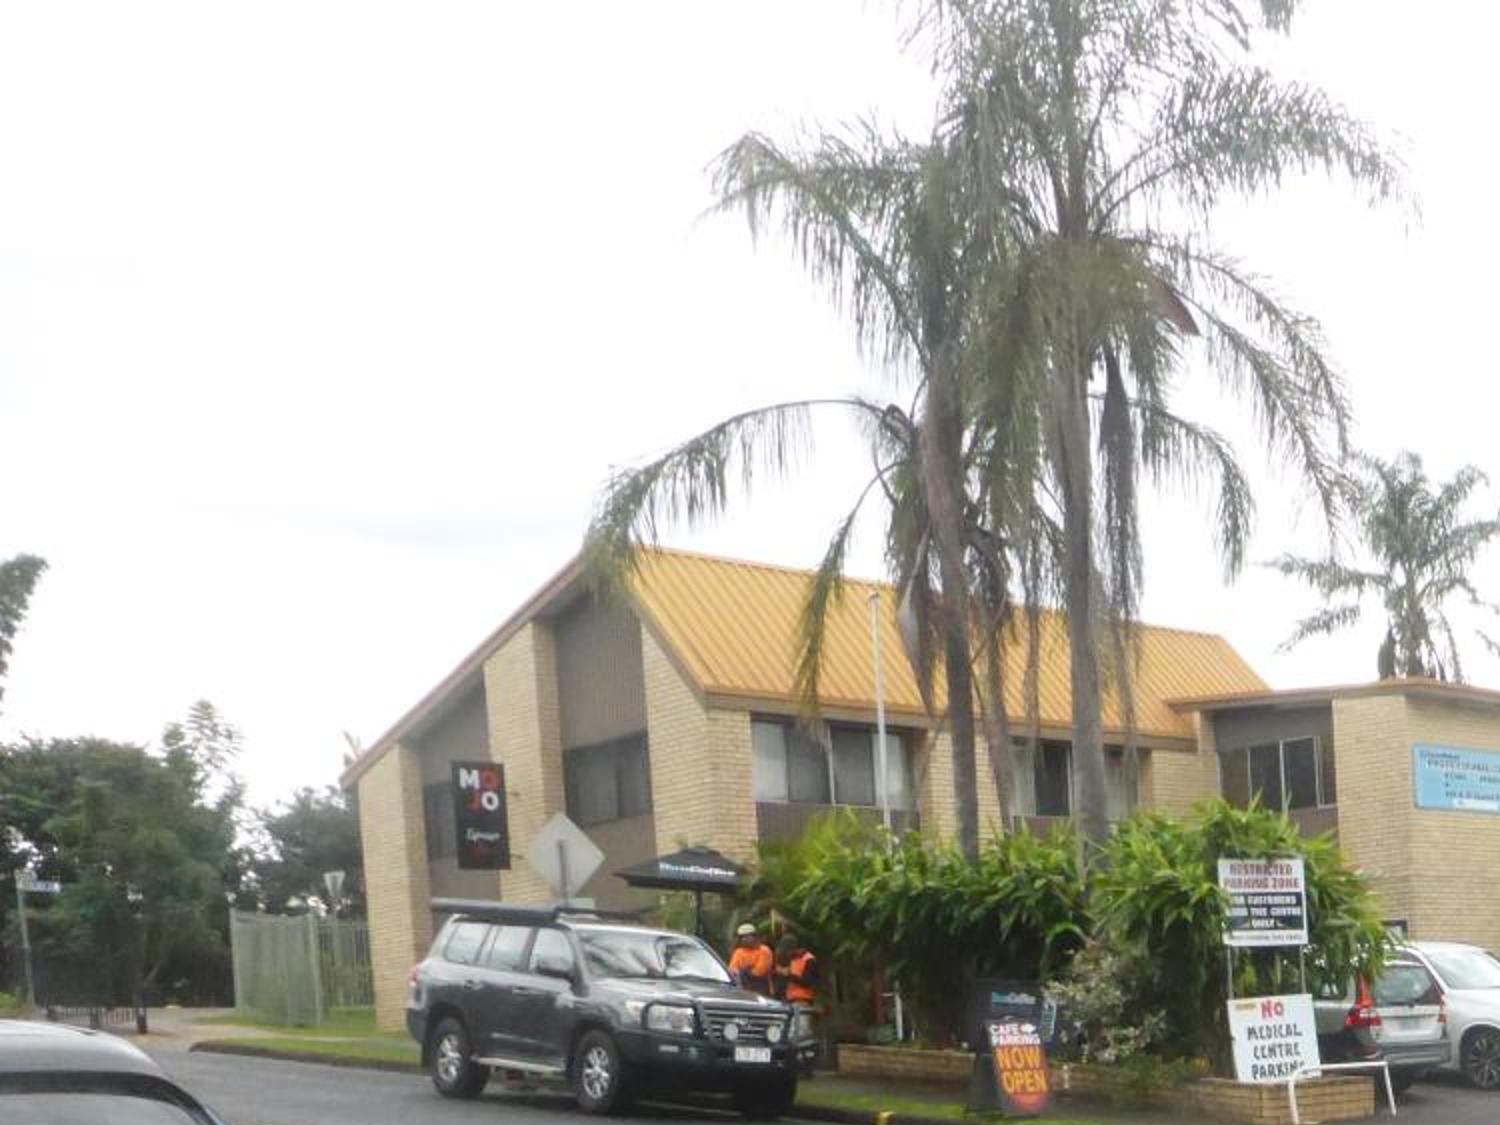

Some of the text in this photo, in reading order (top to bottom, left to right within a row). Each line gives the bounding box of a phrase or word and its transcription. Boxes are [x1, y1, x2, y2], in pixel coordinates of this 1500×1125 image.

[459, 767, 500, 790] MO
[1261, 1000, 1285, 1019] NO
[990, 1024, 1019, 1035] CAFE
[1247, 1024, 1303, 1041] MEDICAL
[996, 1046, 1042, 1069] NOW
[1253, 1042, 1302, 1060] CENTRE
[1002, 1069, 1048, 1094] OPEN
